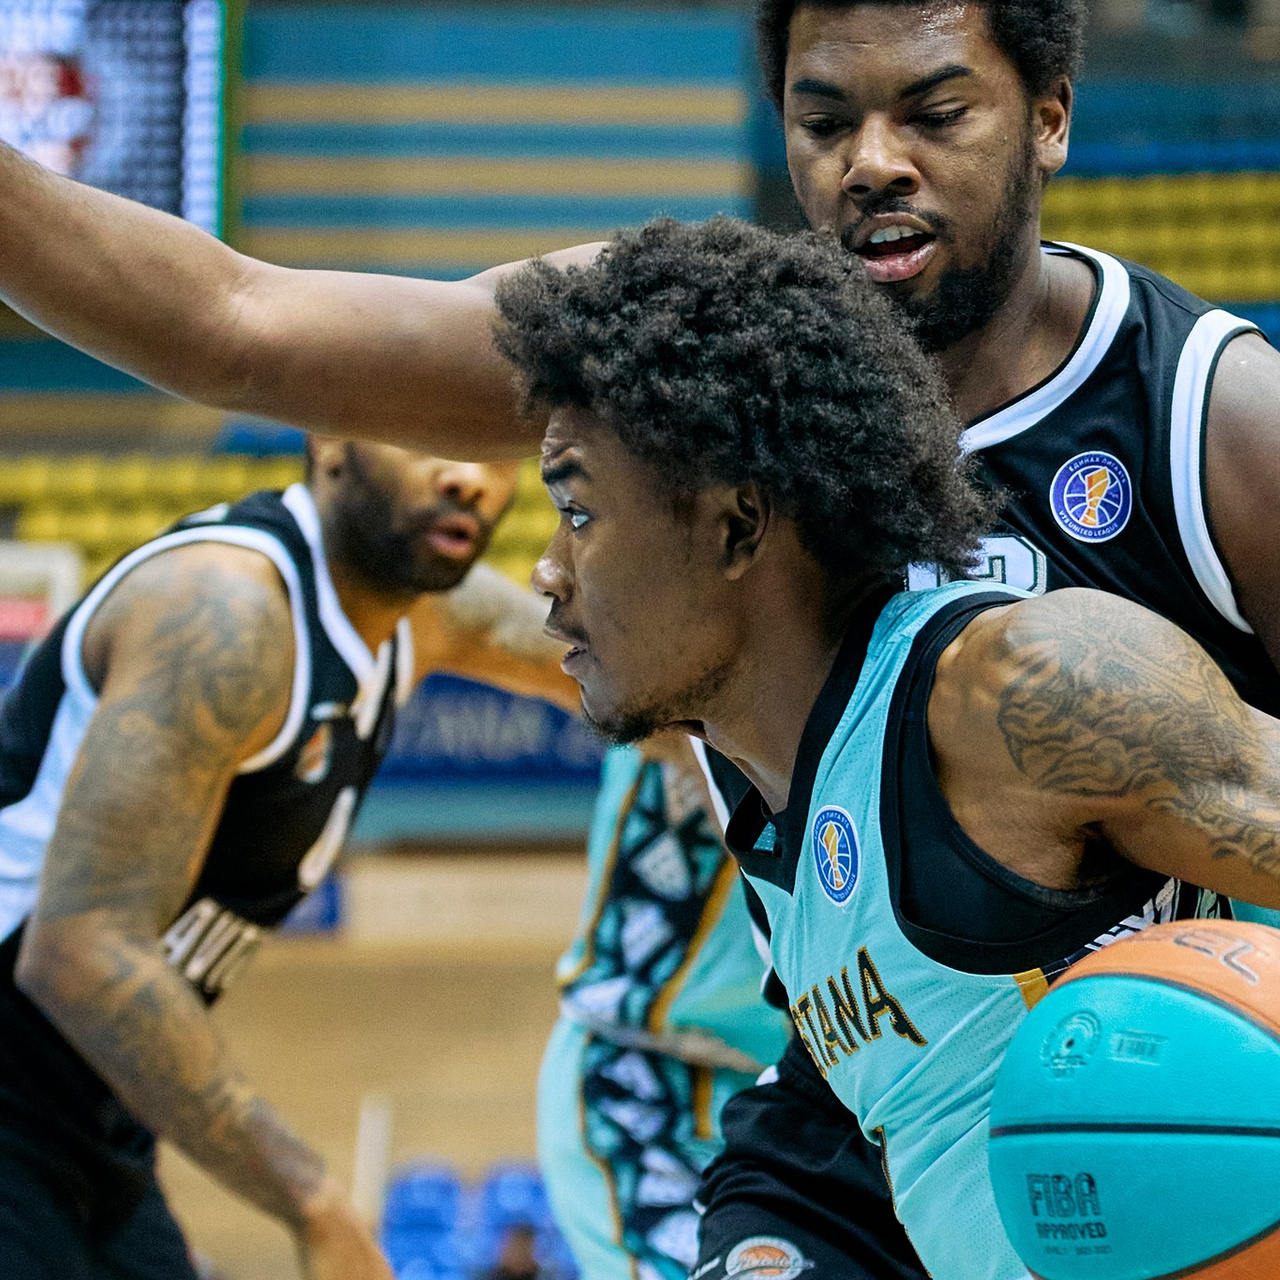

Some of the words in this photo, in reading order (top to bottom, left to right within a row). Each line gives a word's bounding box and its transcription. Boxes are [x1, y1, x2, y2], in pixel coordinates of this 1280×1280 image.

[1067, 522, 1093, 537] UNITED
[1094, 522, 1119, 537] LEAGUE
[1026, 1172, 1101, 1218] FIBA
